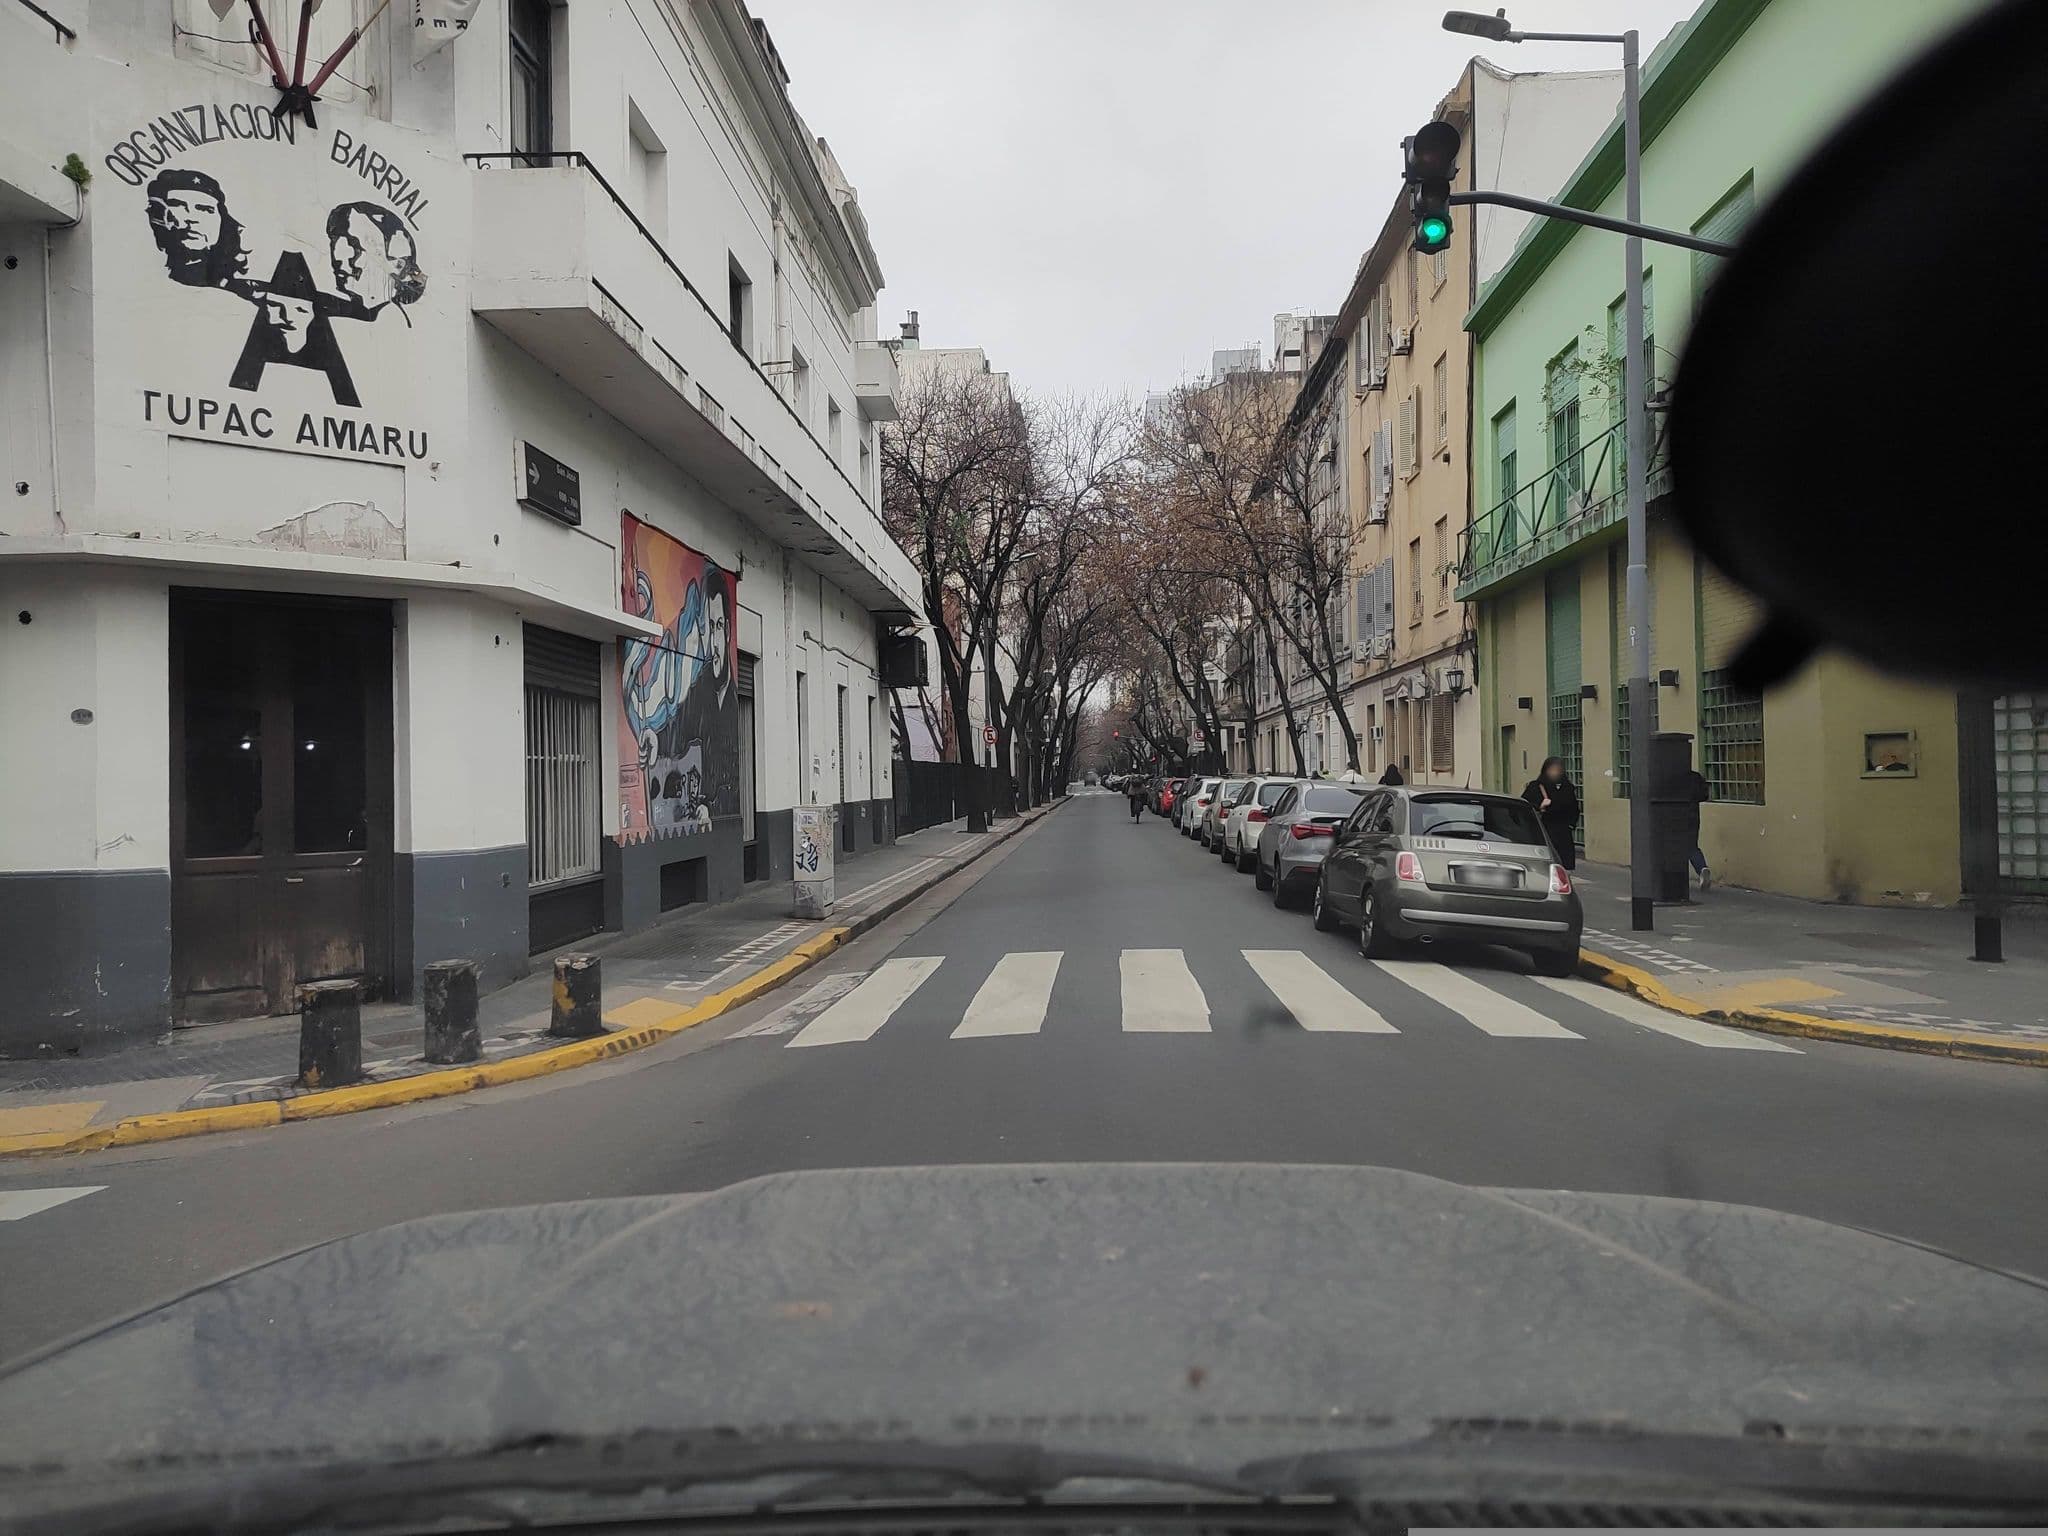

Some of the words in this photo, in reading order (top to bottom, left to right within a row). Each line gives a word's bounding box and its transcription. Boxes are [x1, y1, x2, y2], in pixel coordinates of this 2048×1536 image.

[105, 103, 295, 186] ORGANIZACION
[331, 129, 428, 232] BARRIAL
[144, 390, 274, 439] TUPAC
[296, 413, 428, 460] AMARU
